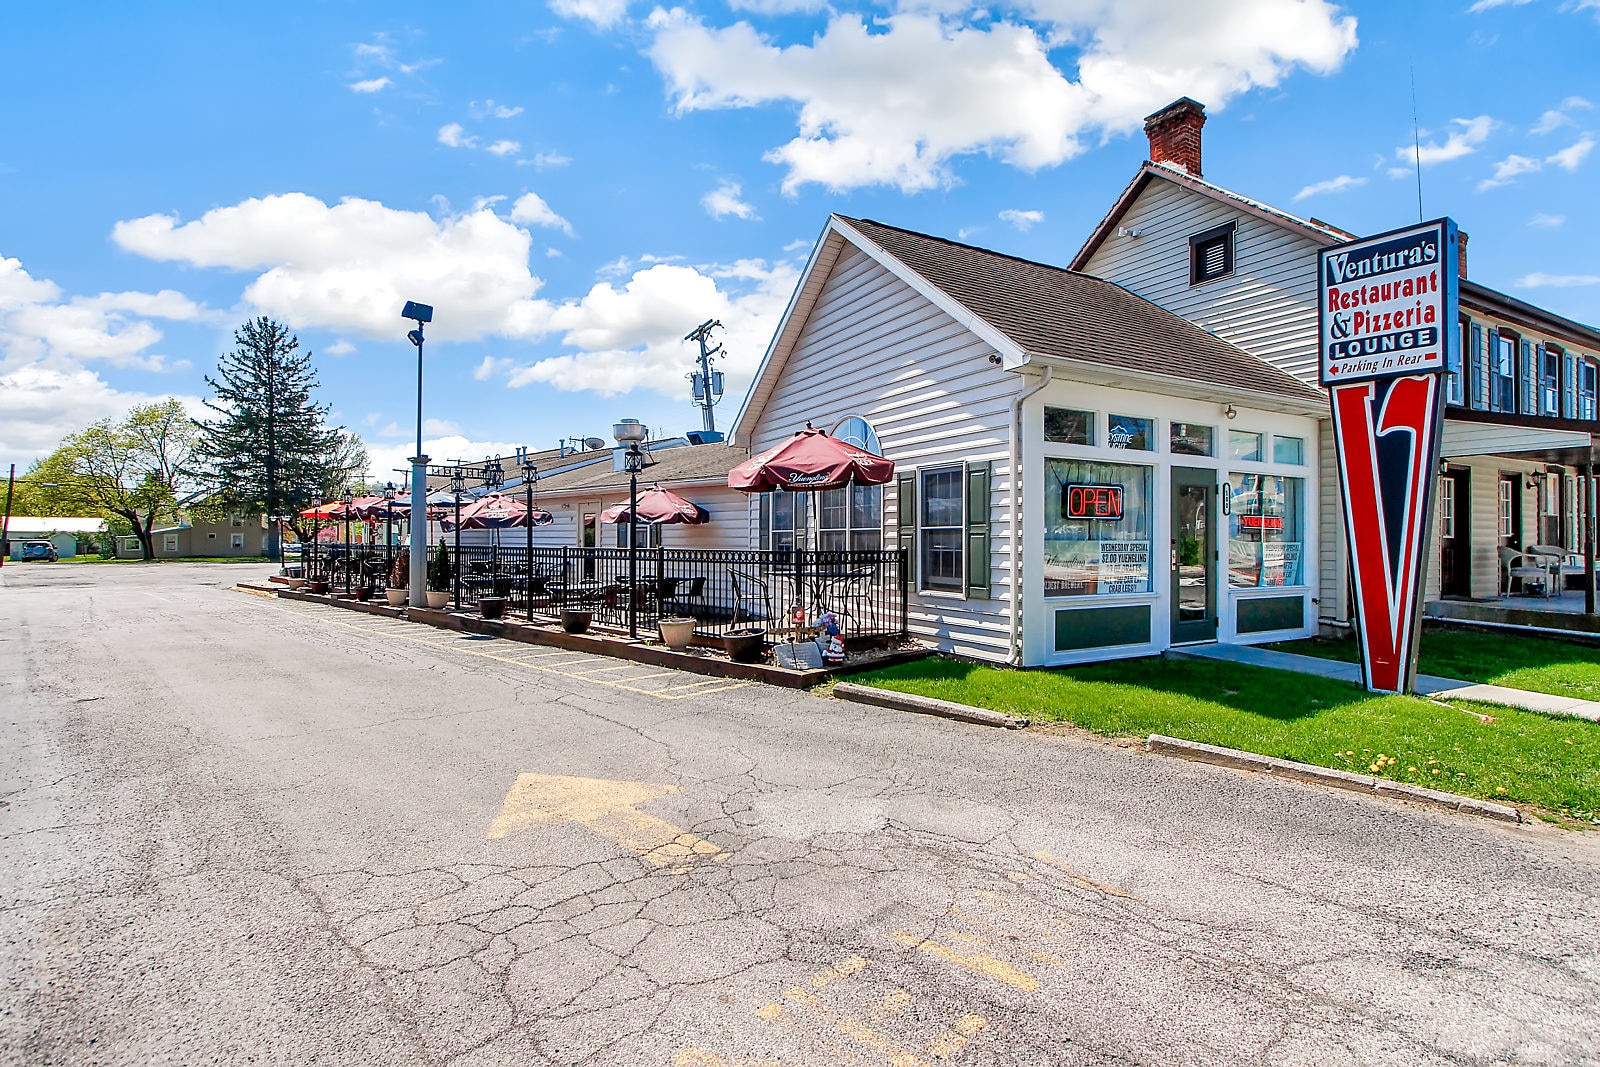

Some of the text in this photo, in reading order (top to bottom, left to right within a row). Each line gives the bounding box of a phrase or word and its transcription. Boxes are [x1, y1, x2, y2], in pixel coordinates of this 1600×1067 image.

[1329, 241, 1436, 284] Ventura's
[1329, 269, 1437, 313] Restaurant
[1331, 300, 1435, 339] & Pizzeria
[1334, 329, 1431, 359] LOUNGE
[1341, 354, 1422, 377] Parking In Rear
[1070, 487, 1121, 516] OPEN
[1101, 543, 1148, 552] WEDNESDAY SPECIAL
[1101, 553, 1147, 564] $2.00 YUENGLING
[1108, 584, 1122, 593] CRAB
